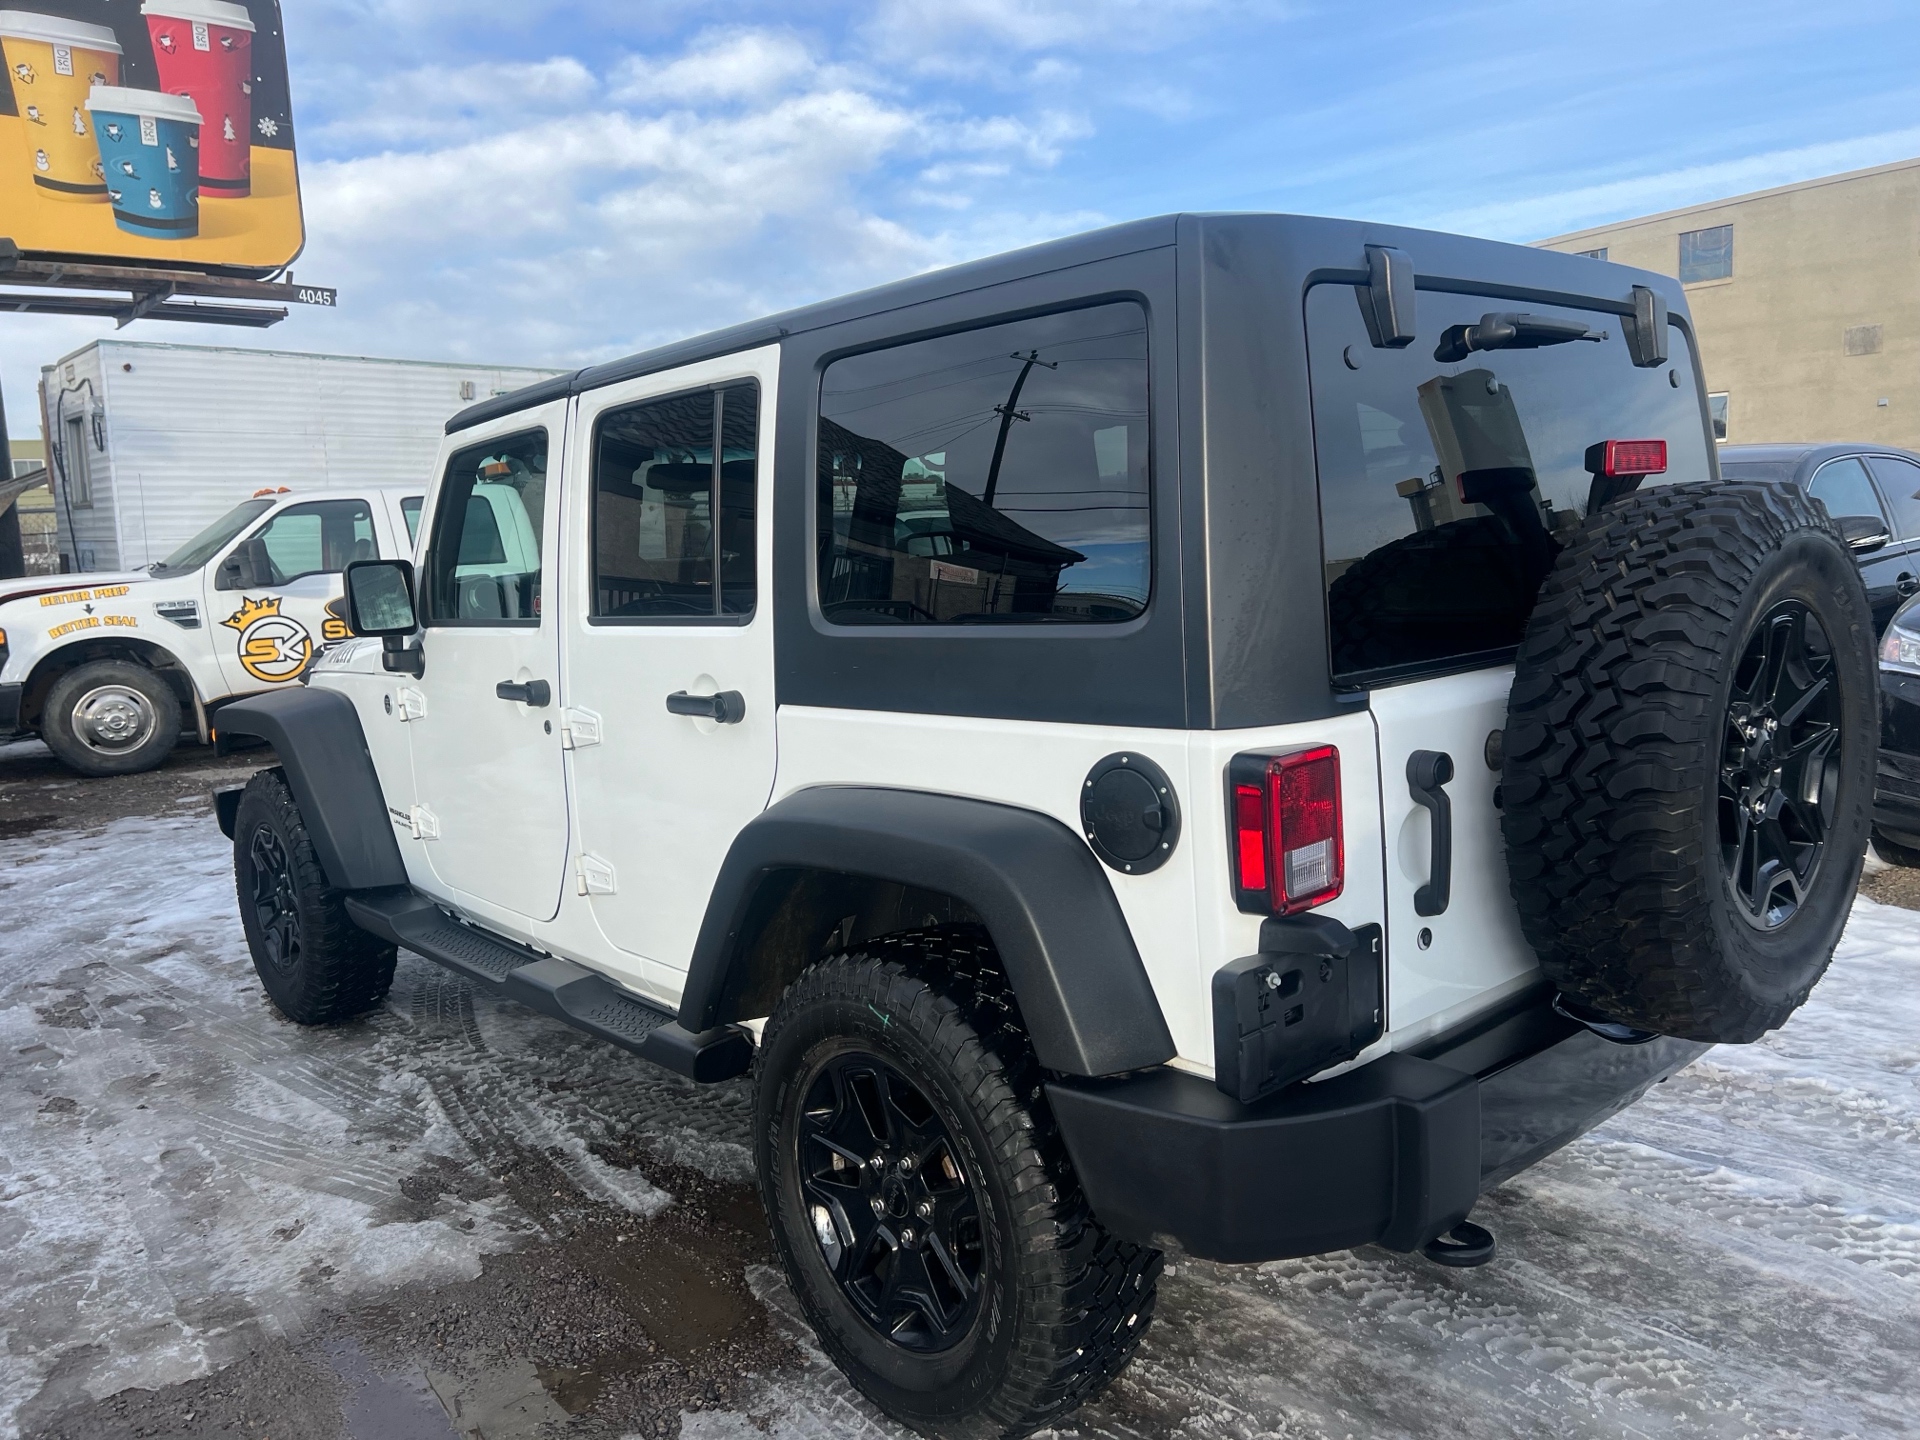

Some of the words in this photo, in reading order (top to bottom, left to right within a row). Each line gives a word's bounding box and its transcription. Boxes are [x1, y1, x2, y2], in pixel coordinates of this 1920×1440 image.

[57, 59, 70, 67] SC
[299, 289, 331, 305] 4045
[39, 590, 91, 607] BETTER
[93, 586, 130, 599] PREP
[48, 616, 101, 640] BETTER
[103, 615, 138, 628] SEAL
